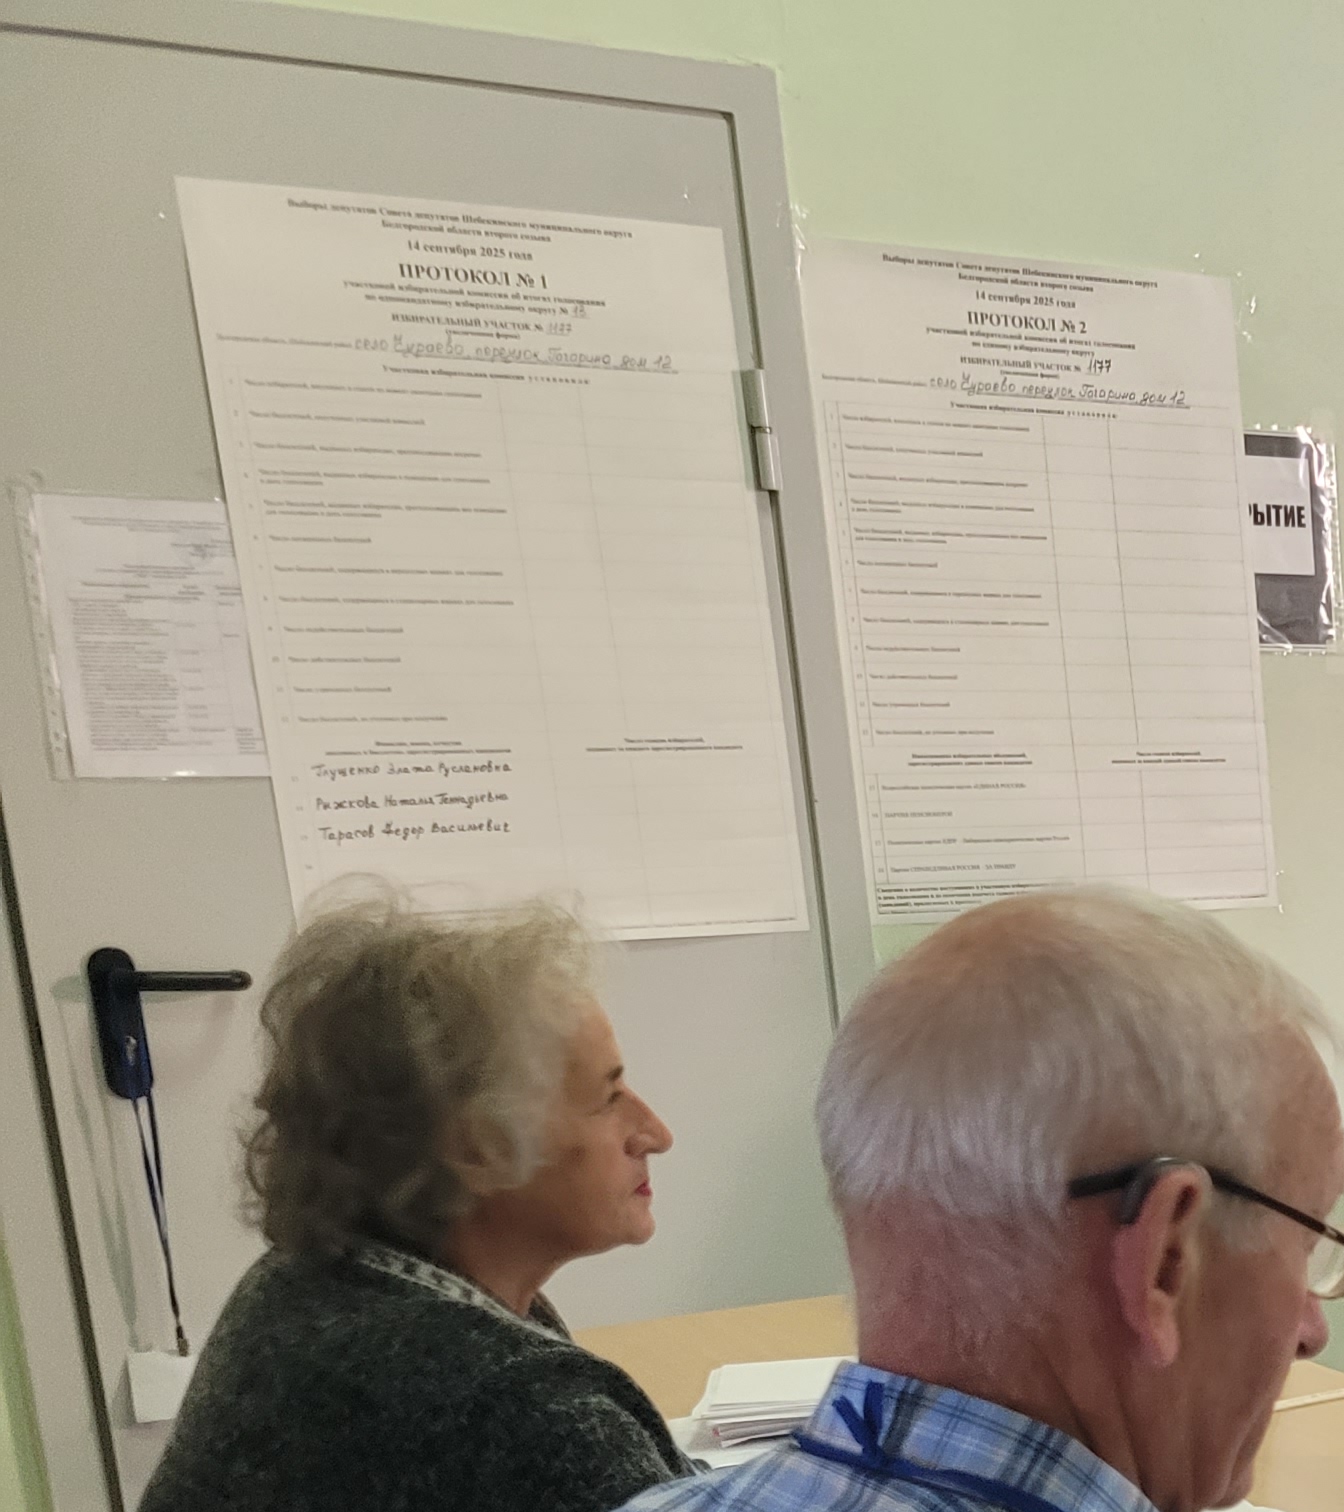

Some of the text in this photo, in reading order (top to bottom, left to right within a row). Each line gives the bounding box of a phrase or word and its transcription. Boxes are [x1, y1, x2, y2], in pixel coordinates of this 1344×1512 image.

[408, 239, 533, 261] 14 сентября 2025 года
[399, 262, 548, 290] ПРОТОКОЛ № 1
[975, 290, 986, 300] 14
[988, 293, 1031, 306] сентября
[1033, 296, 1054, 307] 2025
[967, 311, 1087, 334] ПРОТОКОЛ № 2
[653, 355, 673, 369] 12
[1087, 358, 1112, 374] 1177
[1169, 390, 1185, 405] 12
[1248, 502, 1307, 529] ЫТИЕ
